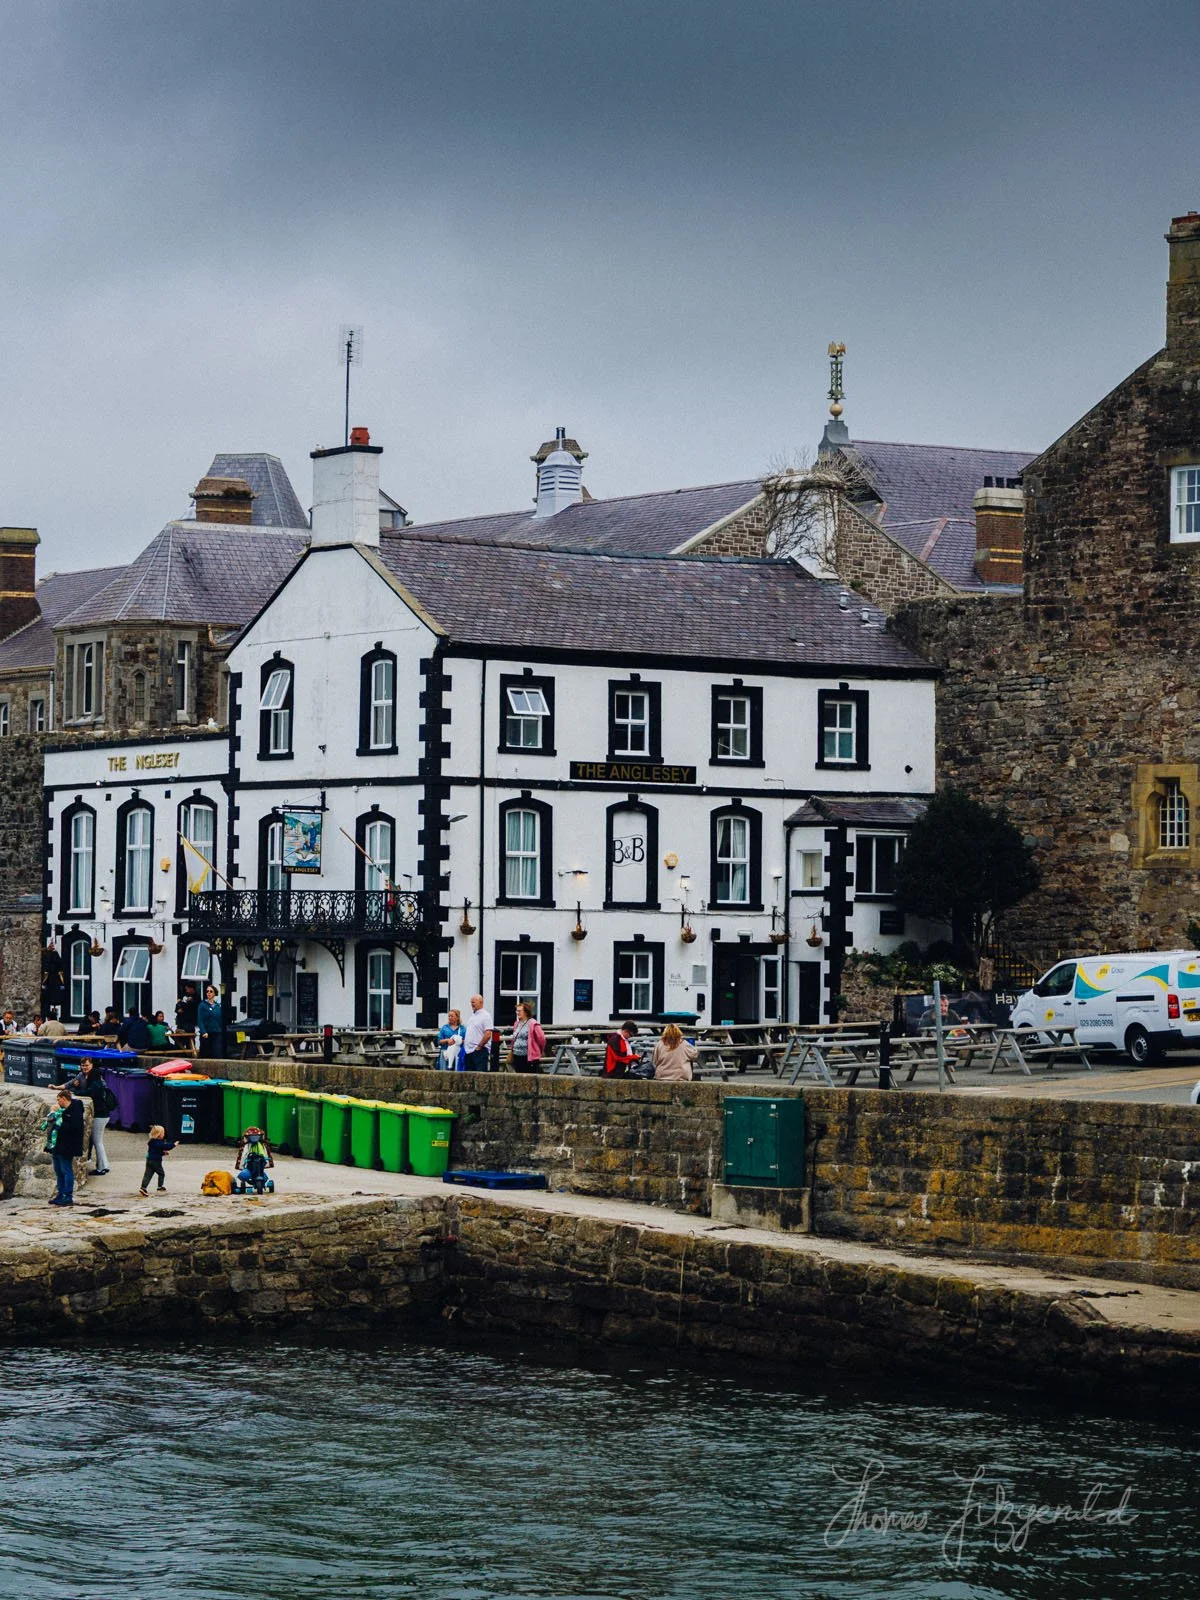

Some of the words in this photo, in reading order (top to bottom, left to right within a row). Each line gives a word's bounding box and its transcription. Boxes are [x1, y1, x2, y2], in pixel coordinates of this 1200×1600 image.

[107, 756, 127, 772] THE
[136, 752, 180, 770] NGLESEY
[576, 763, 606, 779] THE
[609, 765, 690, 781] ANGLESEY
[612, 837, 645, 864] B&B
